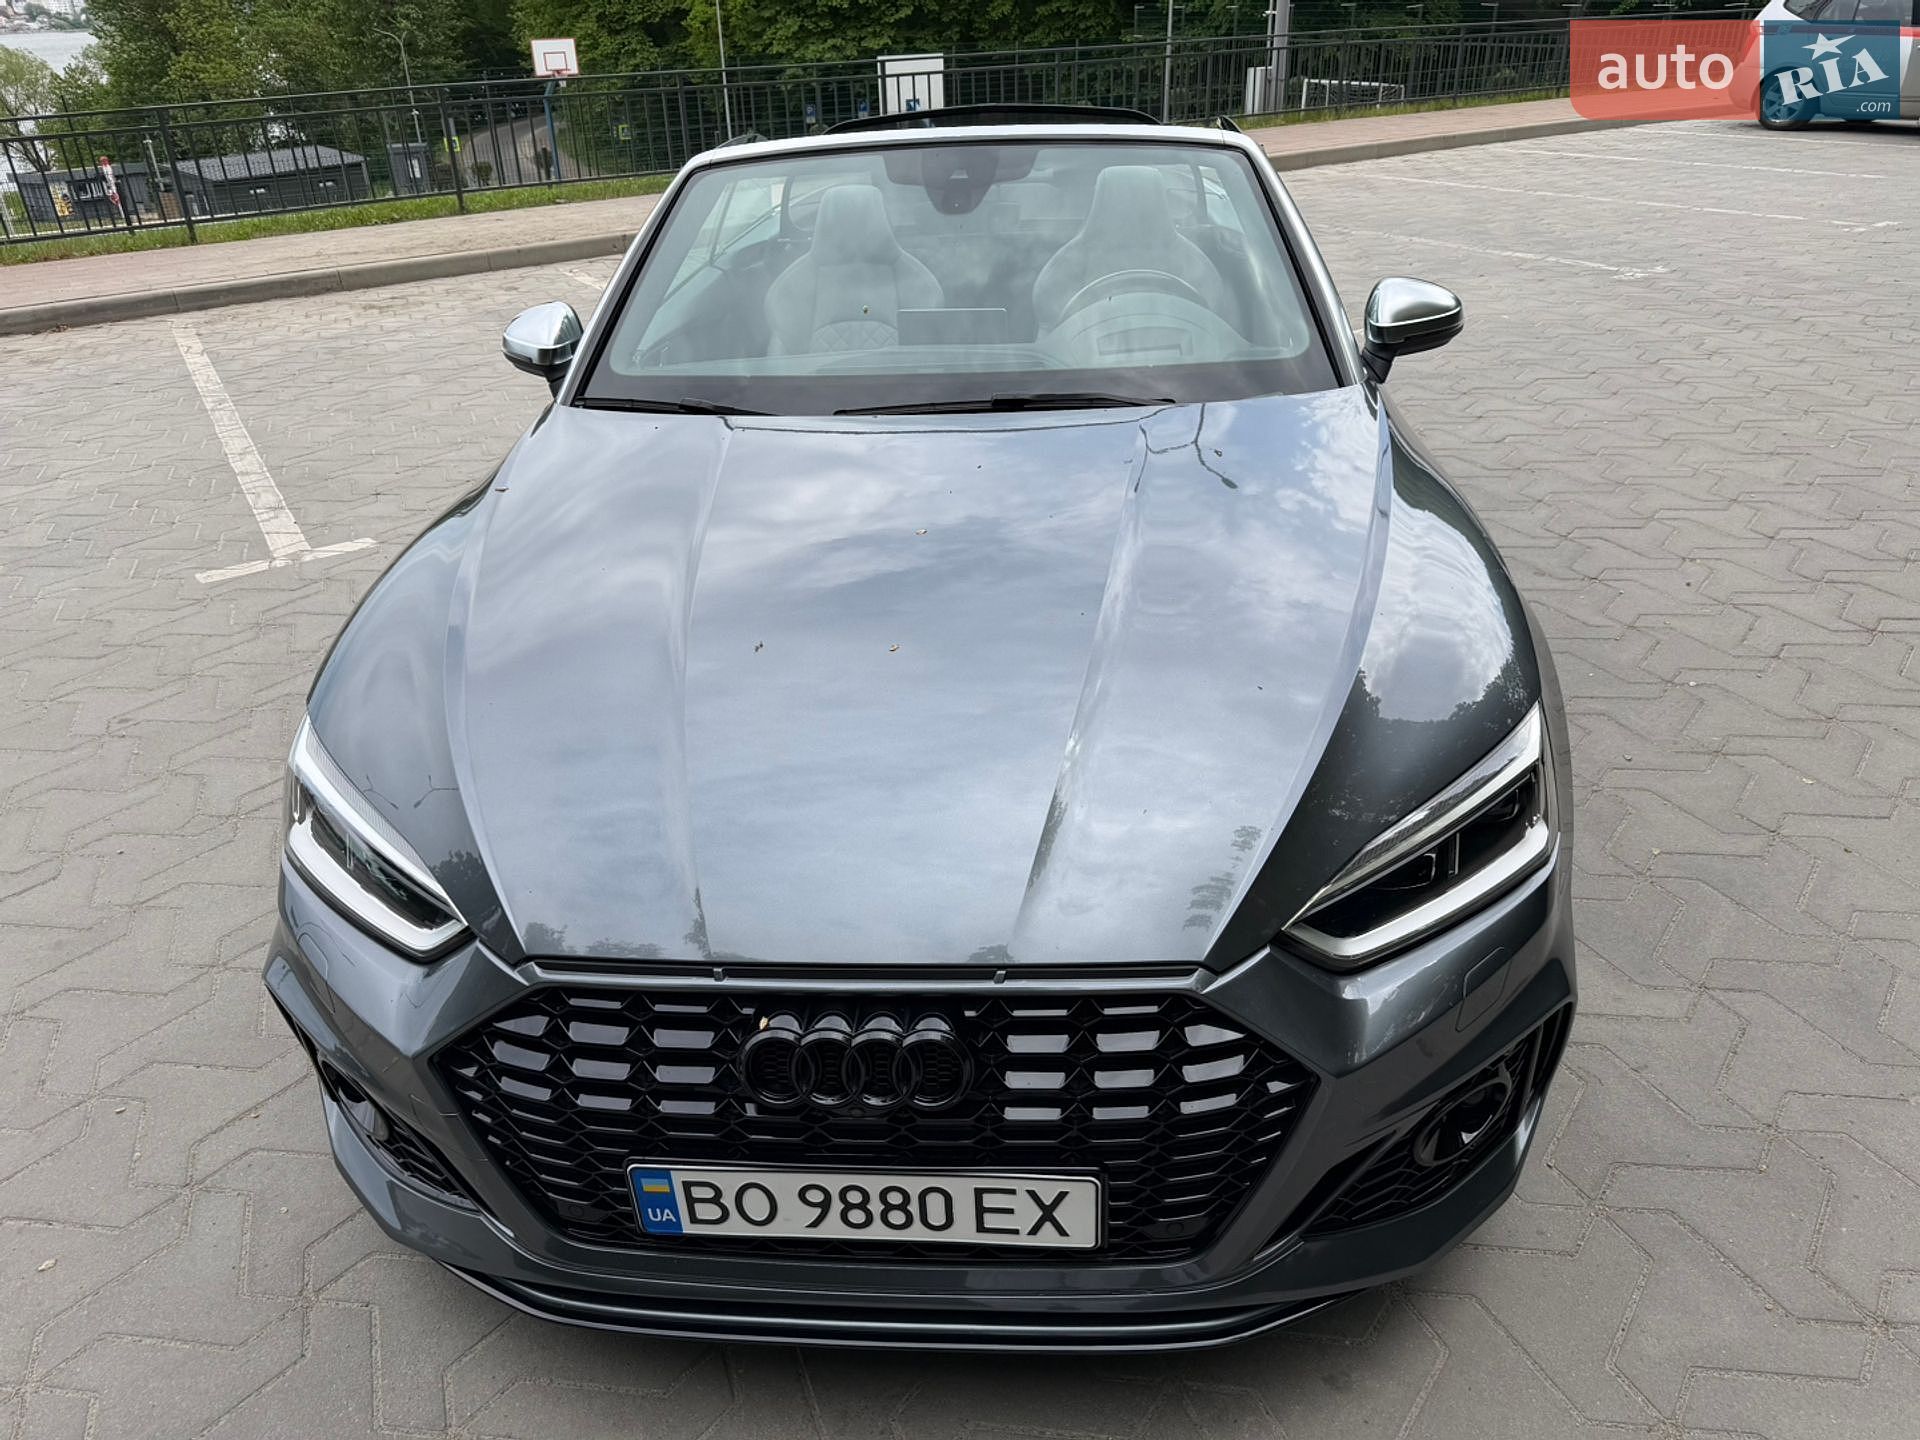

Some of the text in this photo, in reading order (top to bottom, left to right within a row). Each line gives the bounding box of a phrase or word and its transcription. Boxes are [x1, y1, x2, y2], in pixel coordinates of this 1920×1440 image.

[648, 1208, 677, 1222] UA
[681, 1180, 1071, 1238] BO 9880 EX
